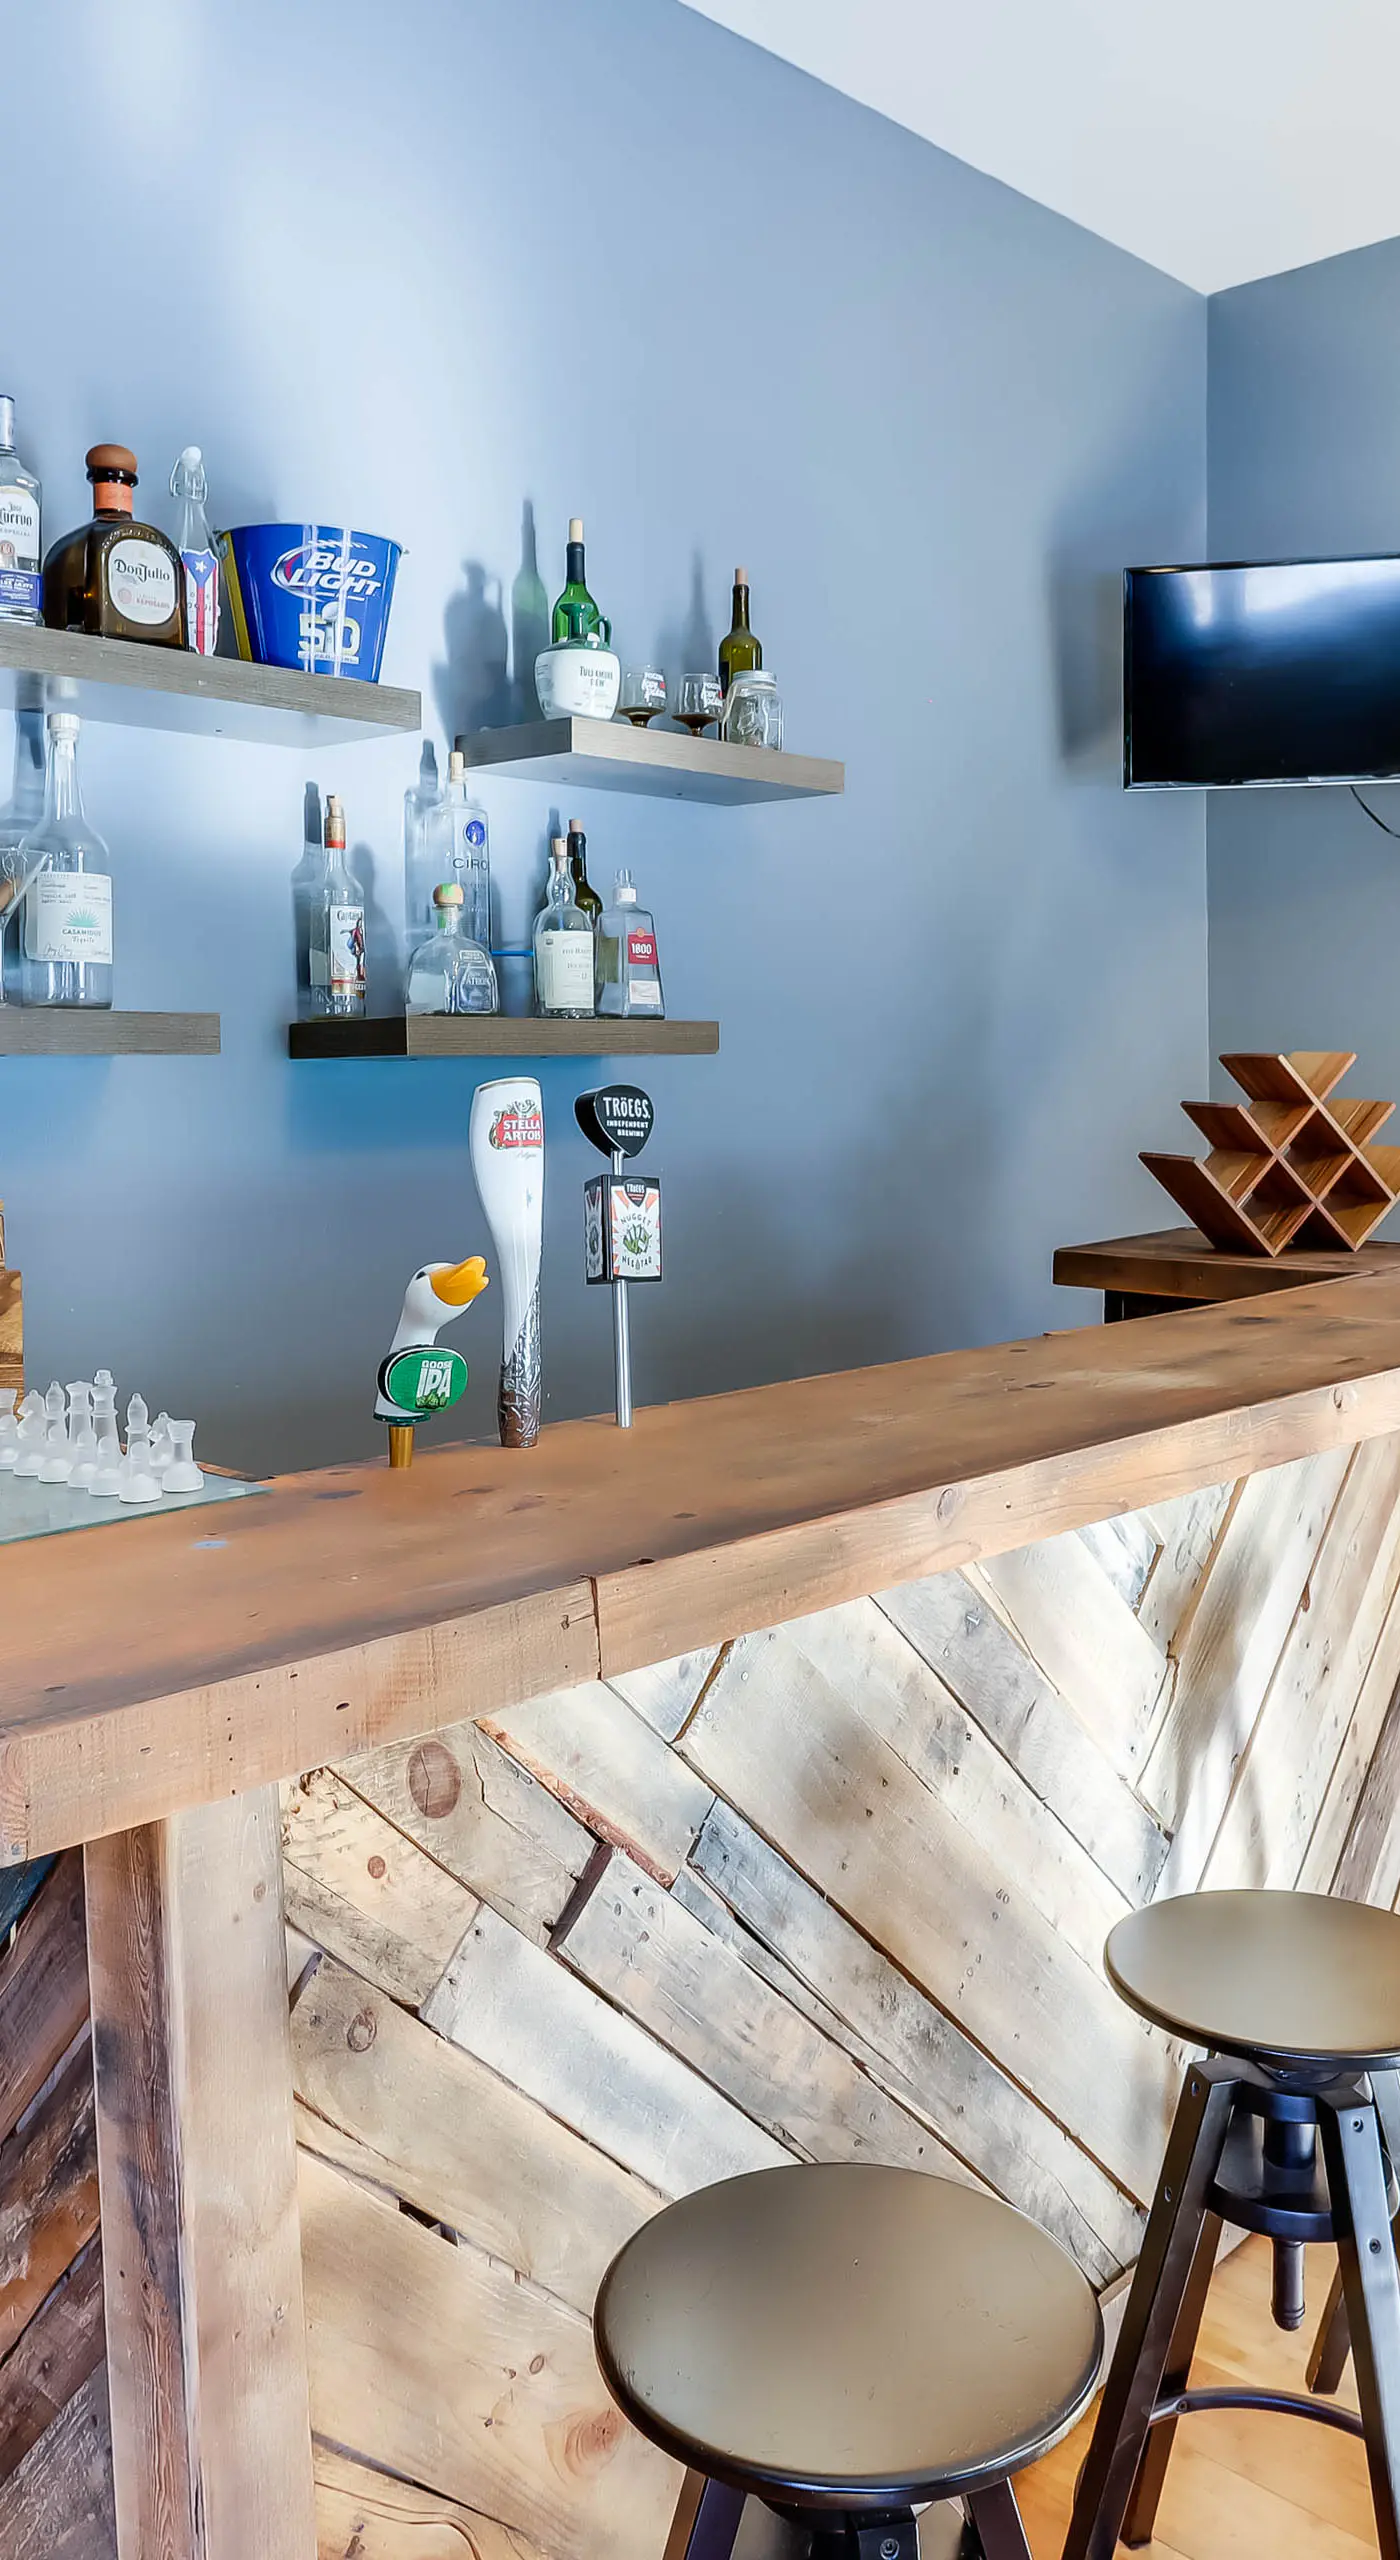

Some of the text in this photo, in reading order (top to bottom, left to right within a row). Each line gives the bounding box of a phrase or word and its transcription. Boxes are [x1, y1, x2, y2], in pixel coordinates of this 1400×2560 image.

[305, 551, 377, 577] BUD
[288, 568, 382, 596] LIGHT
[631, 943, 652, 954] 1800
[503, 1119, 541, 1130] STELLA
[606, 1119, 649, 1129] INDEPENDENT
[617, 1129, 644, 1137] BREWING
[621, 1213, 652, 1226] NUGGET
[416, 1367, 452, 1399] IPA
